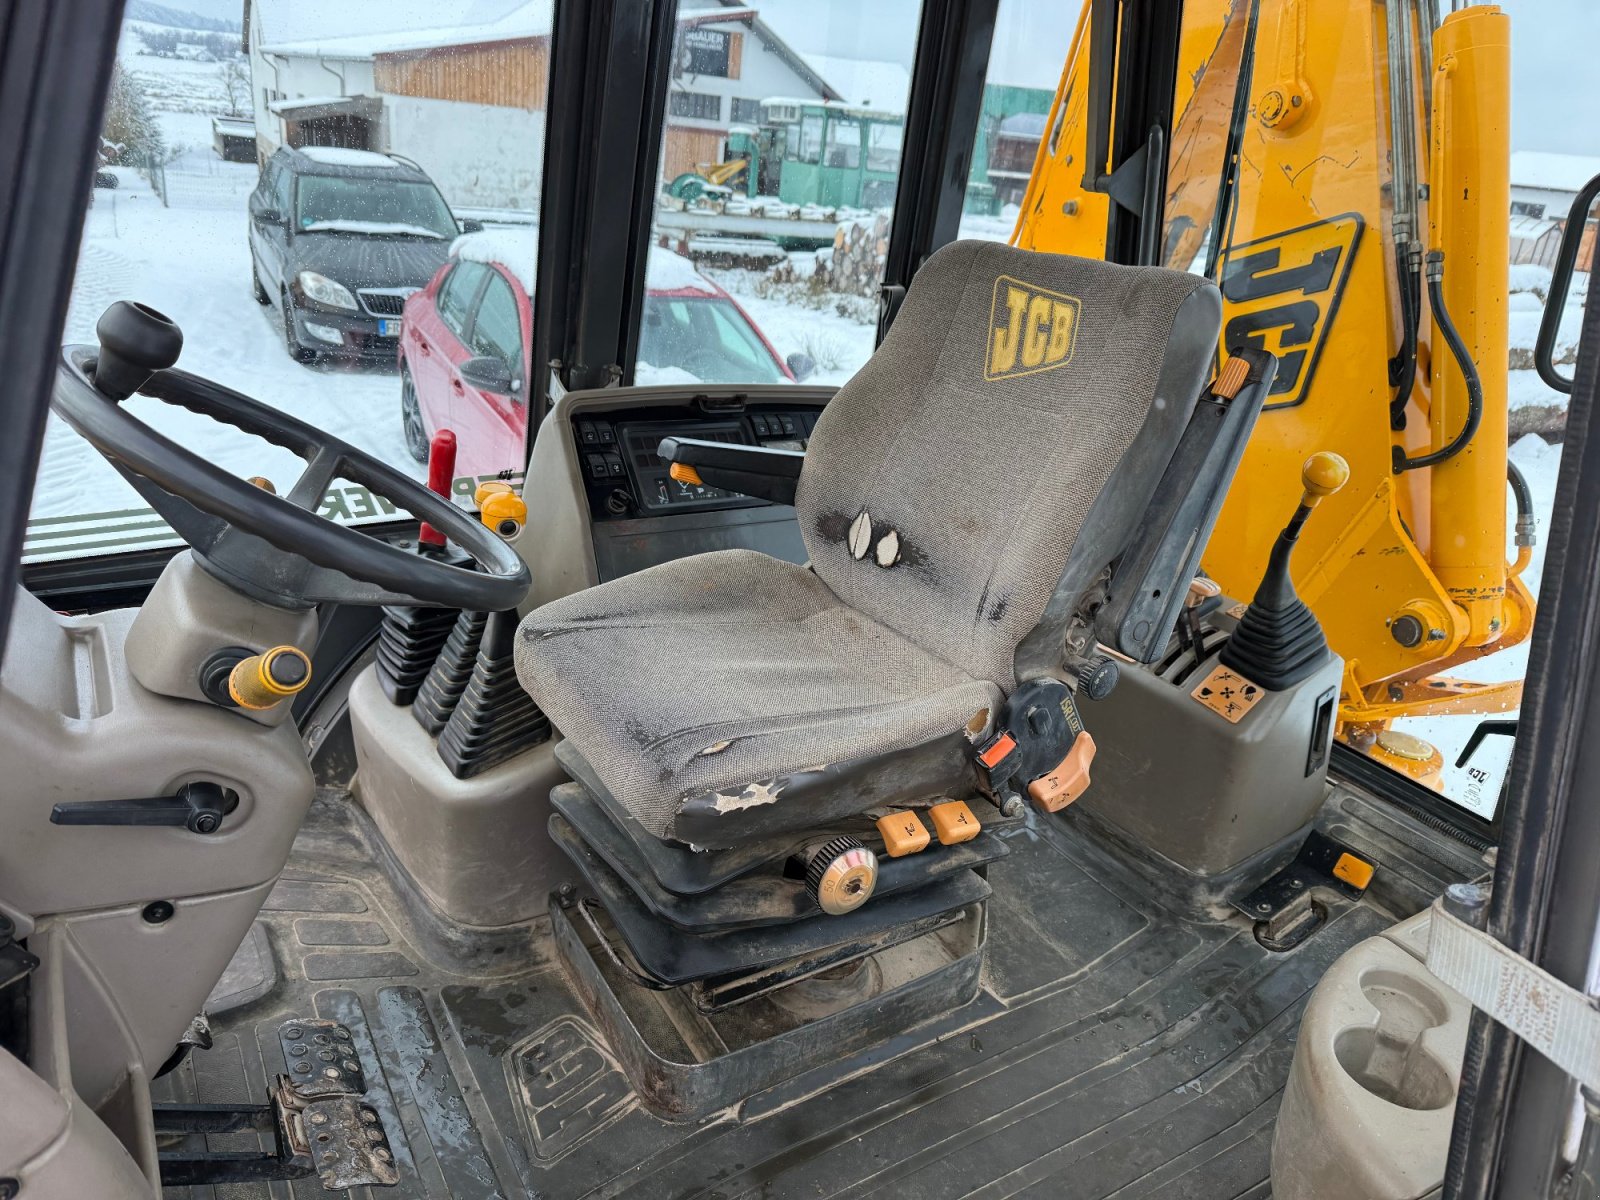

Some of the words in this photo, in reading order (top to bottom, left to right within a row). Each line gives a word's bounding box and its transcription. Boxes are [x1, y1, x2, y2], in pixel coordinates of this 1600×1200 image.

[991, 286, 1075, 374] JCB
[1060, 696, 1075, 721] ISRI
[824, 879, 836, 894] 50
[519, 1028, 631, 1141] JCB
